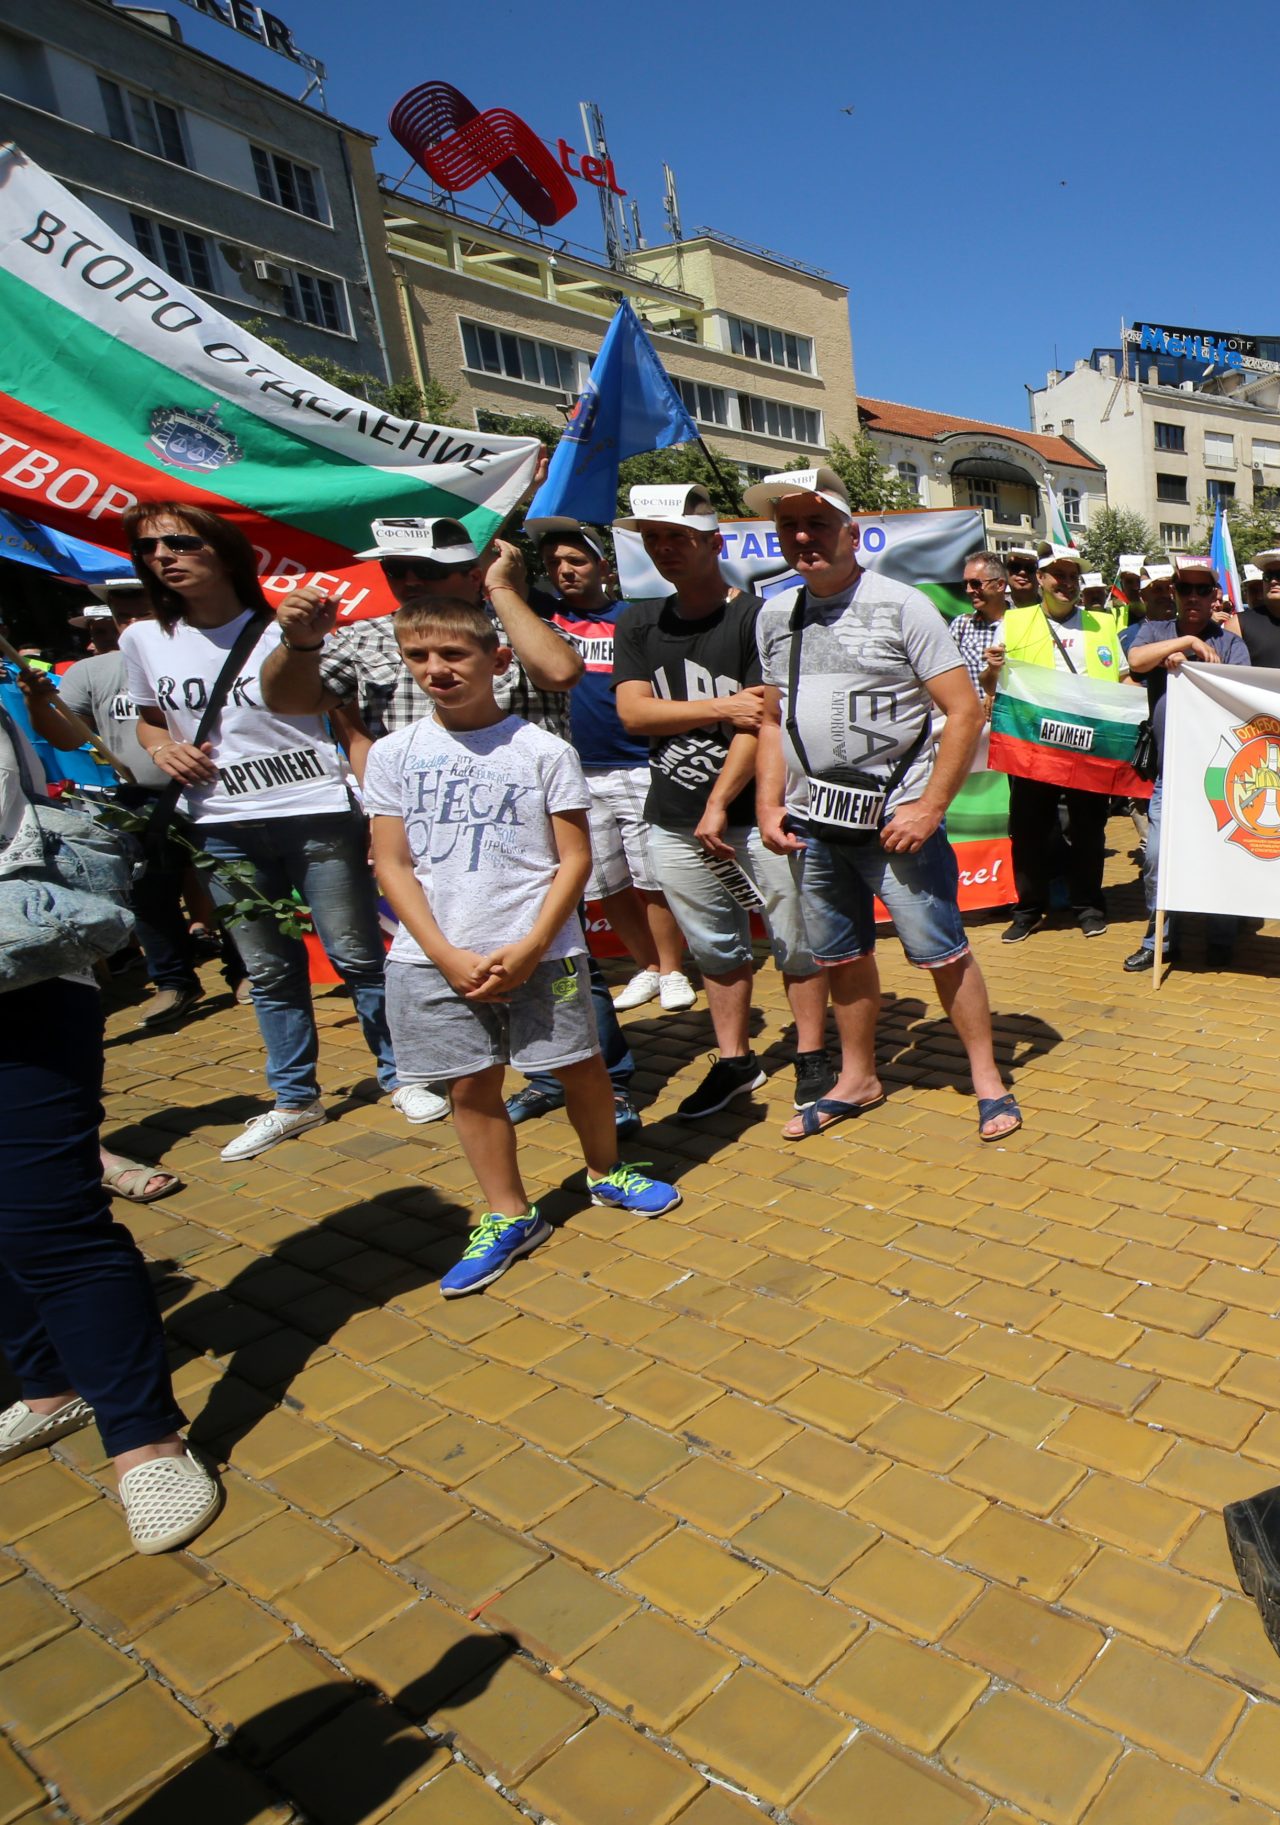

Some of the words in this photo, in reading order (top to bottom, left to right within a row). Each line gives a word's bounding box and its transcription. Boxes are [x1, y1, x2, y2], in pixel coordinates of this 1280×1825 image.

[557, 138, 627, 196] tel
[21, 209, 203, 333] ВТОРО
[203, 342, 500, 477] ОТДЕЛЕНИЕ
[1140, 324, 1243, 369] MetLife
[633, 497, 683, 508] СФСМВР
[376, 529, 431, 539] СФСМВР
[156, 676, 257, 711] ROK
[830, 690, 846, 743] EMPORIO
[1041, 721, 1092, 748] АРГУМЕНТ
[219, 749, 327, 796] АРГУМЕНТ
[403, 770, 538, 826] HECK
